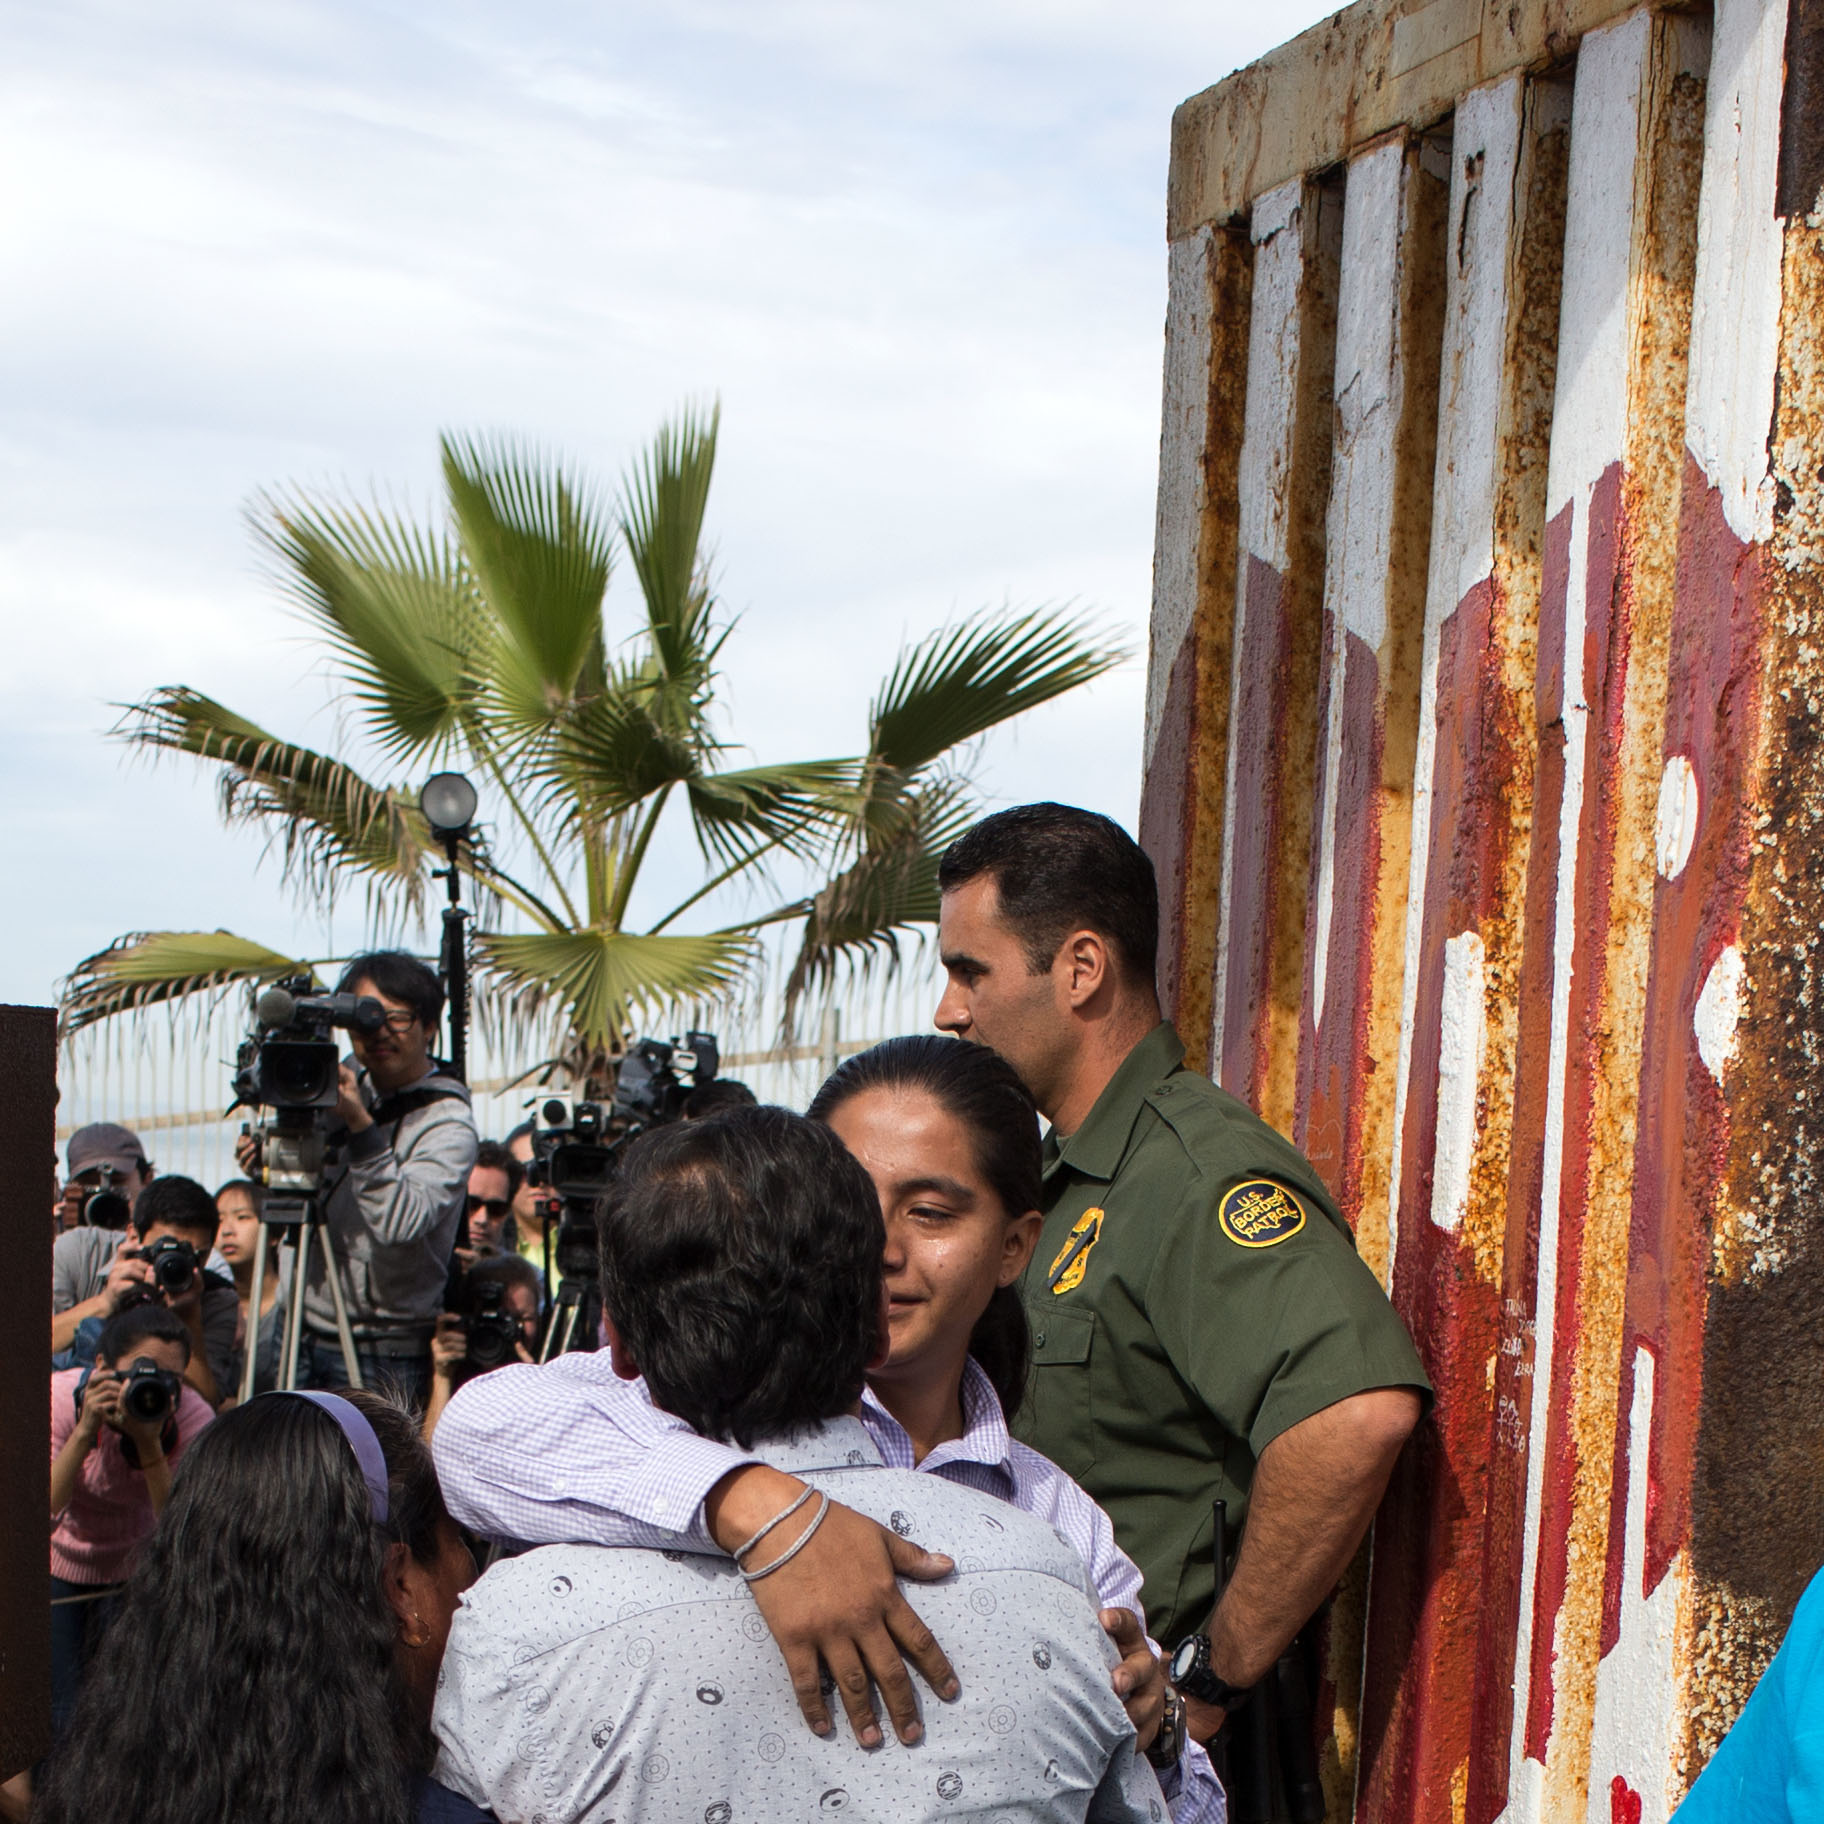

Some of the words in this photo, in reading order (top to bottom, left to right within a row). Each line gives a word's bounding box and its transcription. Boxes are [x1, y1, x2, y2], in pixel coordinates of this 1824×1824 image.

[1234, 1194, 1284, 1229] BORDER
[1237, 1191, 1264, 1208] U.S.
[1244, 1206, 1299, 1239] PATROL
